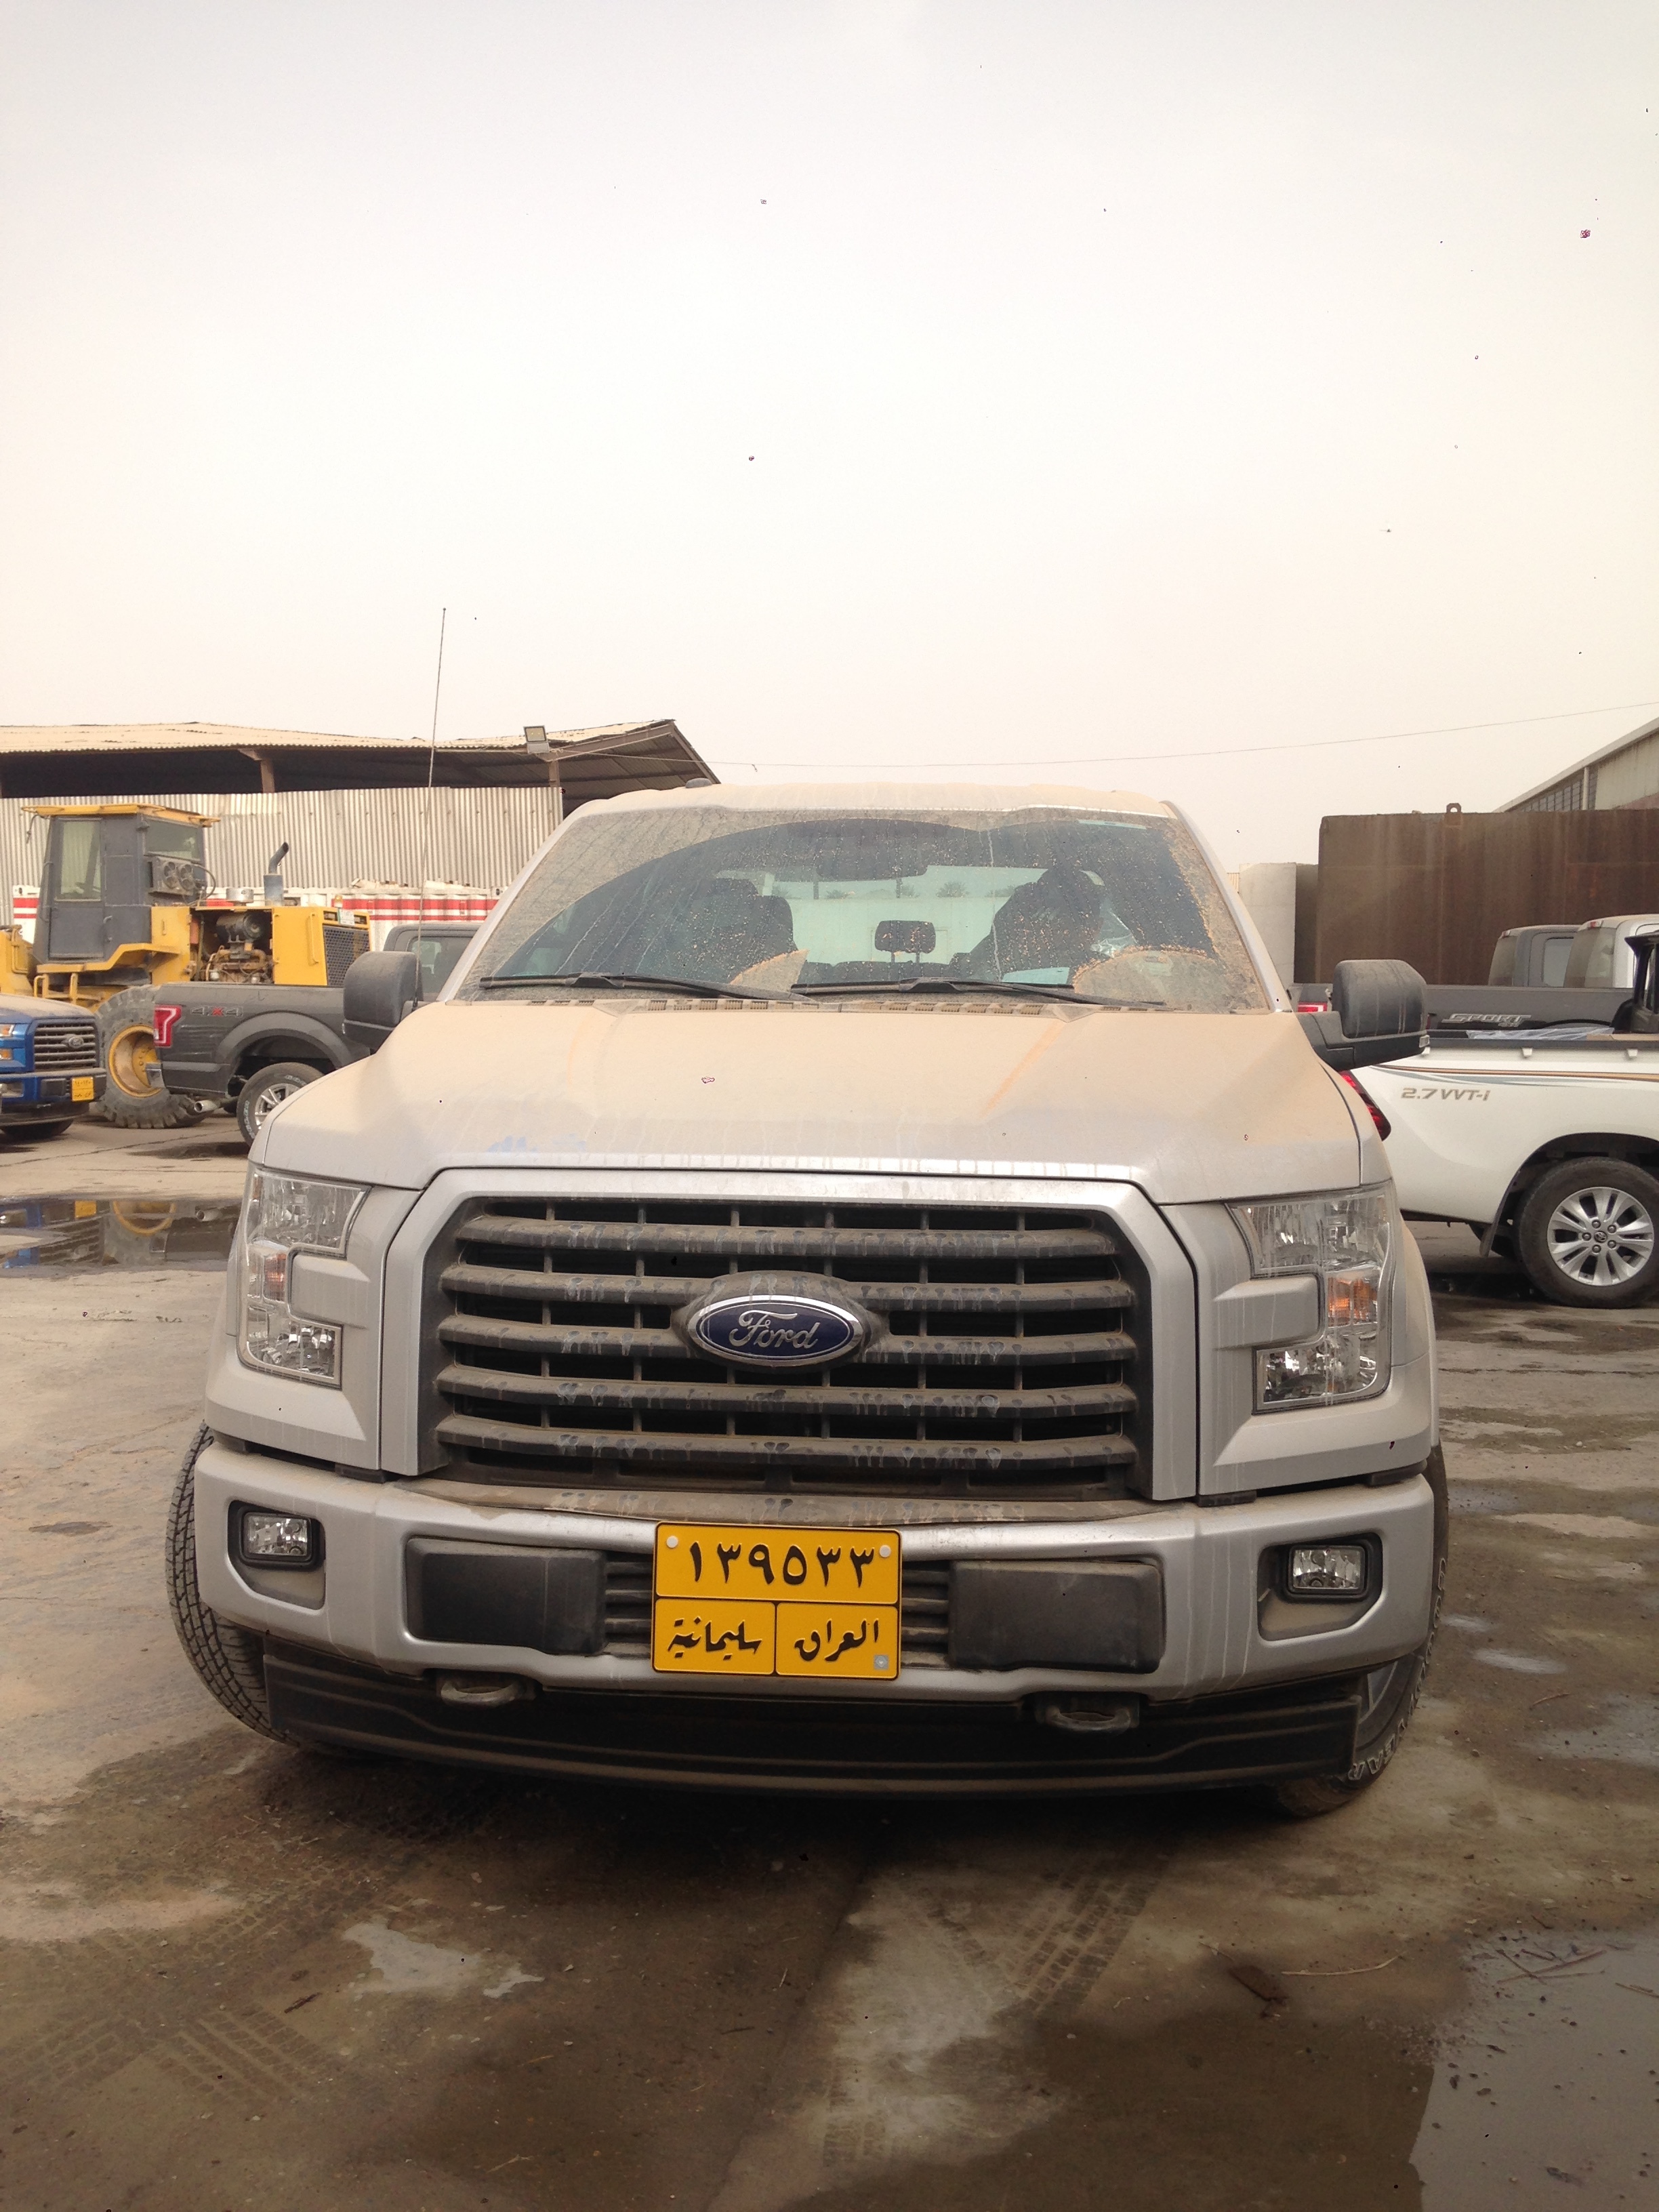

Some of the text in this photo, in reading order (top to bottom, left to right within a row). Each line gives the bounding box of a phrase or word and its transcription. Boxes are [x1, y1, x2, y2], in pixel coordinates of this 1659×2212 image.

[1441, 1013, 1532, 1024] SPORT
[729, 1309, 821, 1349] Ford
[689, 1541, 874, 1589] ١٣٩٥٣٣
[667, 1615, 879, 1662] العراق سليمانية
